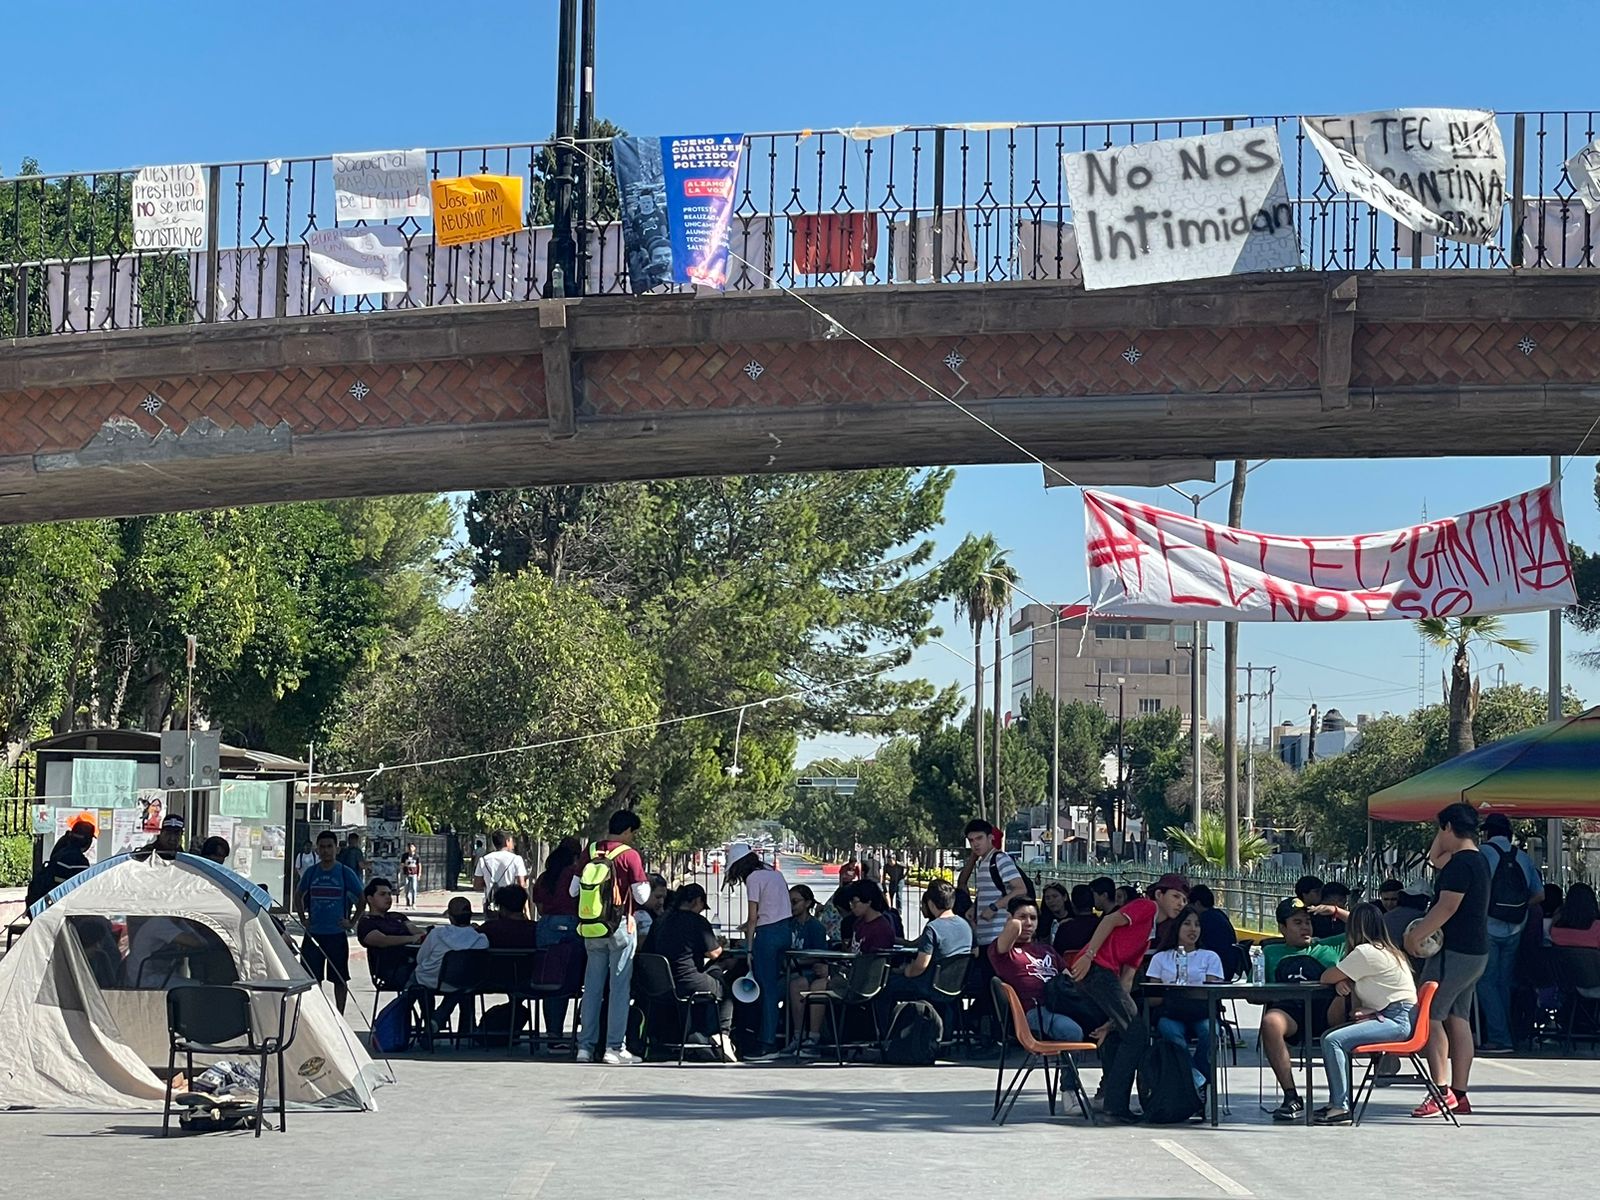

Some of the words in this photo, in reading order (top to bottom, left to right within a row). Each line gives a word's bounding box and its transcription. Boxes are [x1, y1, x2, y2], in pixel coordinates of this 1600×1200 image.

[672, 138, 715, 147] AJENO
[1371, 116, 1433, 154] TEC
[337, 156, 387, 176] Saquen
[391, 149, 408, 168] al
[673, 152, 728, 161] PARTIDO
[674, 160, 737, 169] POLITICO
[1085, 152, 1153, 197] No
[136, 201, 155, 217] NO
[160, 201, 174, 214] se
[472, 188, 498, 204] JUAN
[1087, 196, 1293, 262] Intimidan
[1407, 487, 1577, 595] CANTINA
[1263, 577, 1349, 622] NO
